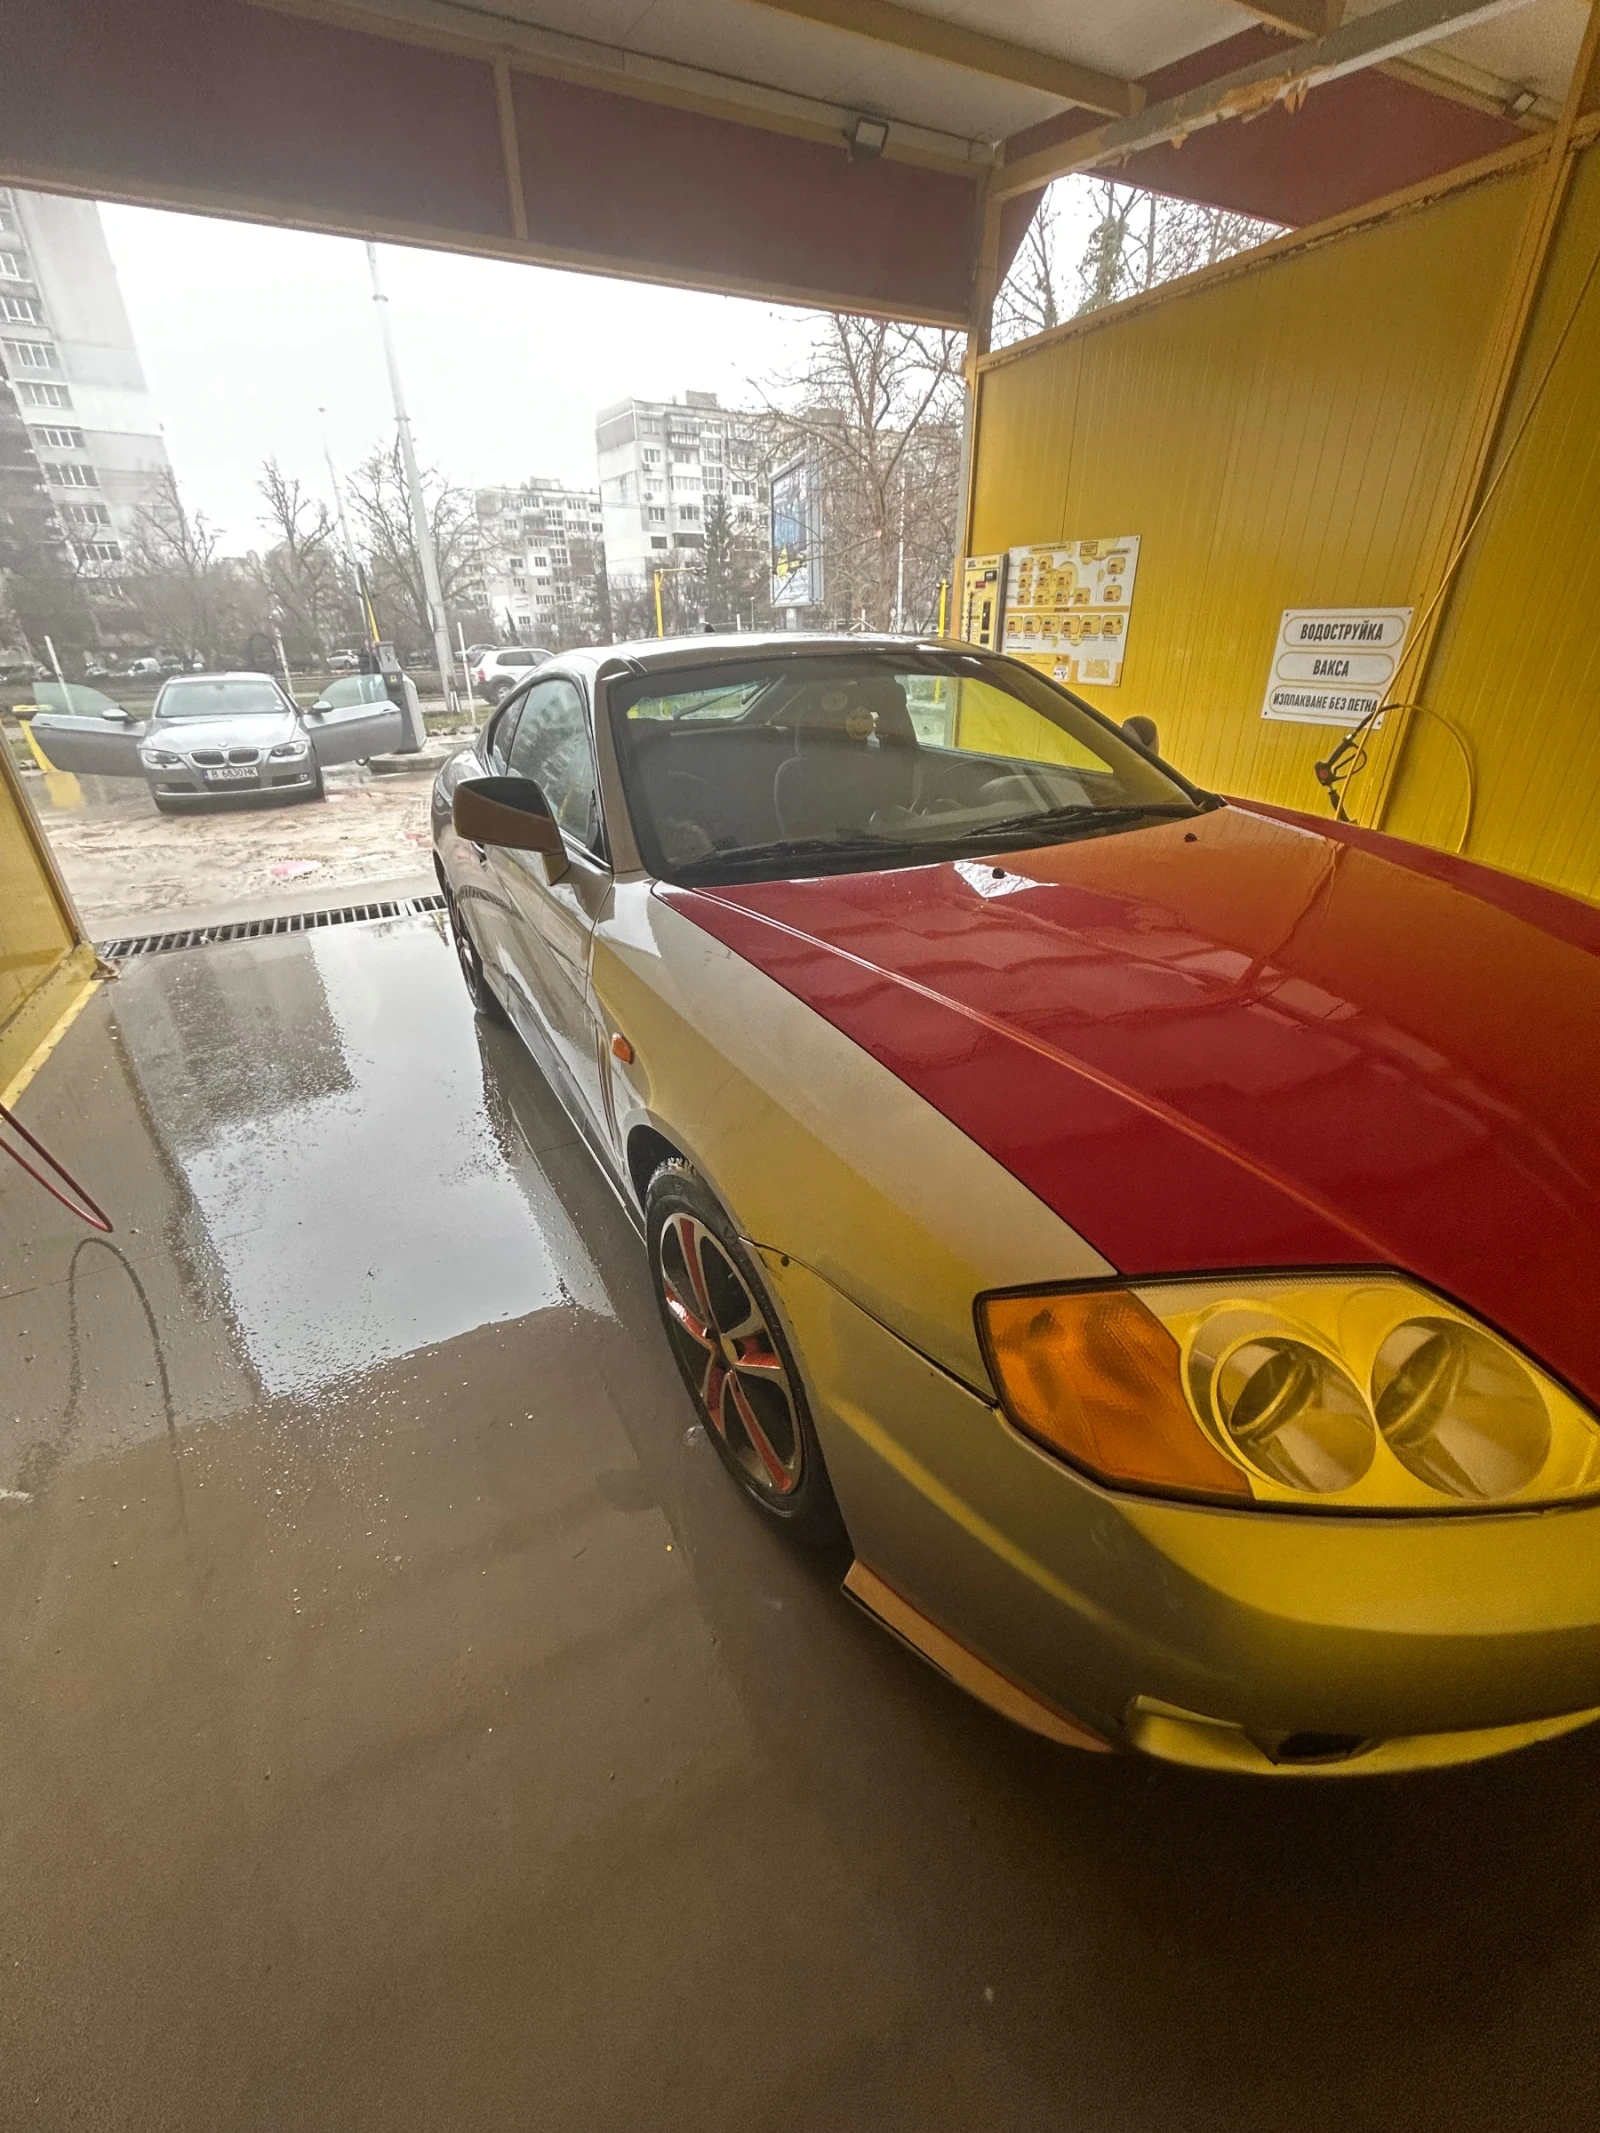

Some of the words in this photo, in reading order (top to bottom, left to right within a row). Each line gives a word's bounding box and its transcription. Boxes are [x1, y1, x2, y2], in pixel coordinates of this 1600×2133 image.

[1300, 620, 1384, 641] ВОДОСТРУЙКА
[1312, 659, 1350, 677] ВАКСА
[1273, 693, 1328, 709] ИЗПЛАКВАНЕ
[1328, 696, 1346, 711] БЕЗ
[1347, 698, 1378, 713] ПЕТНА
